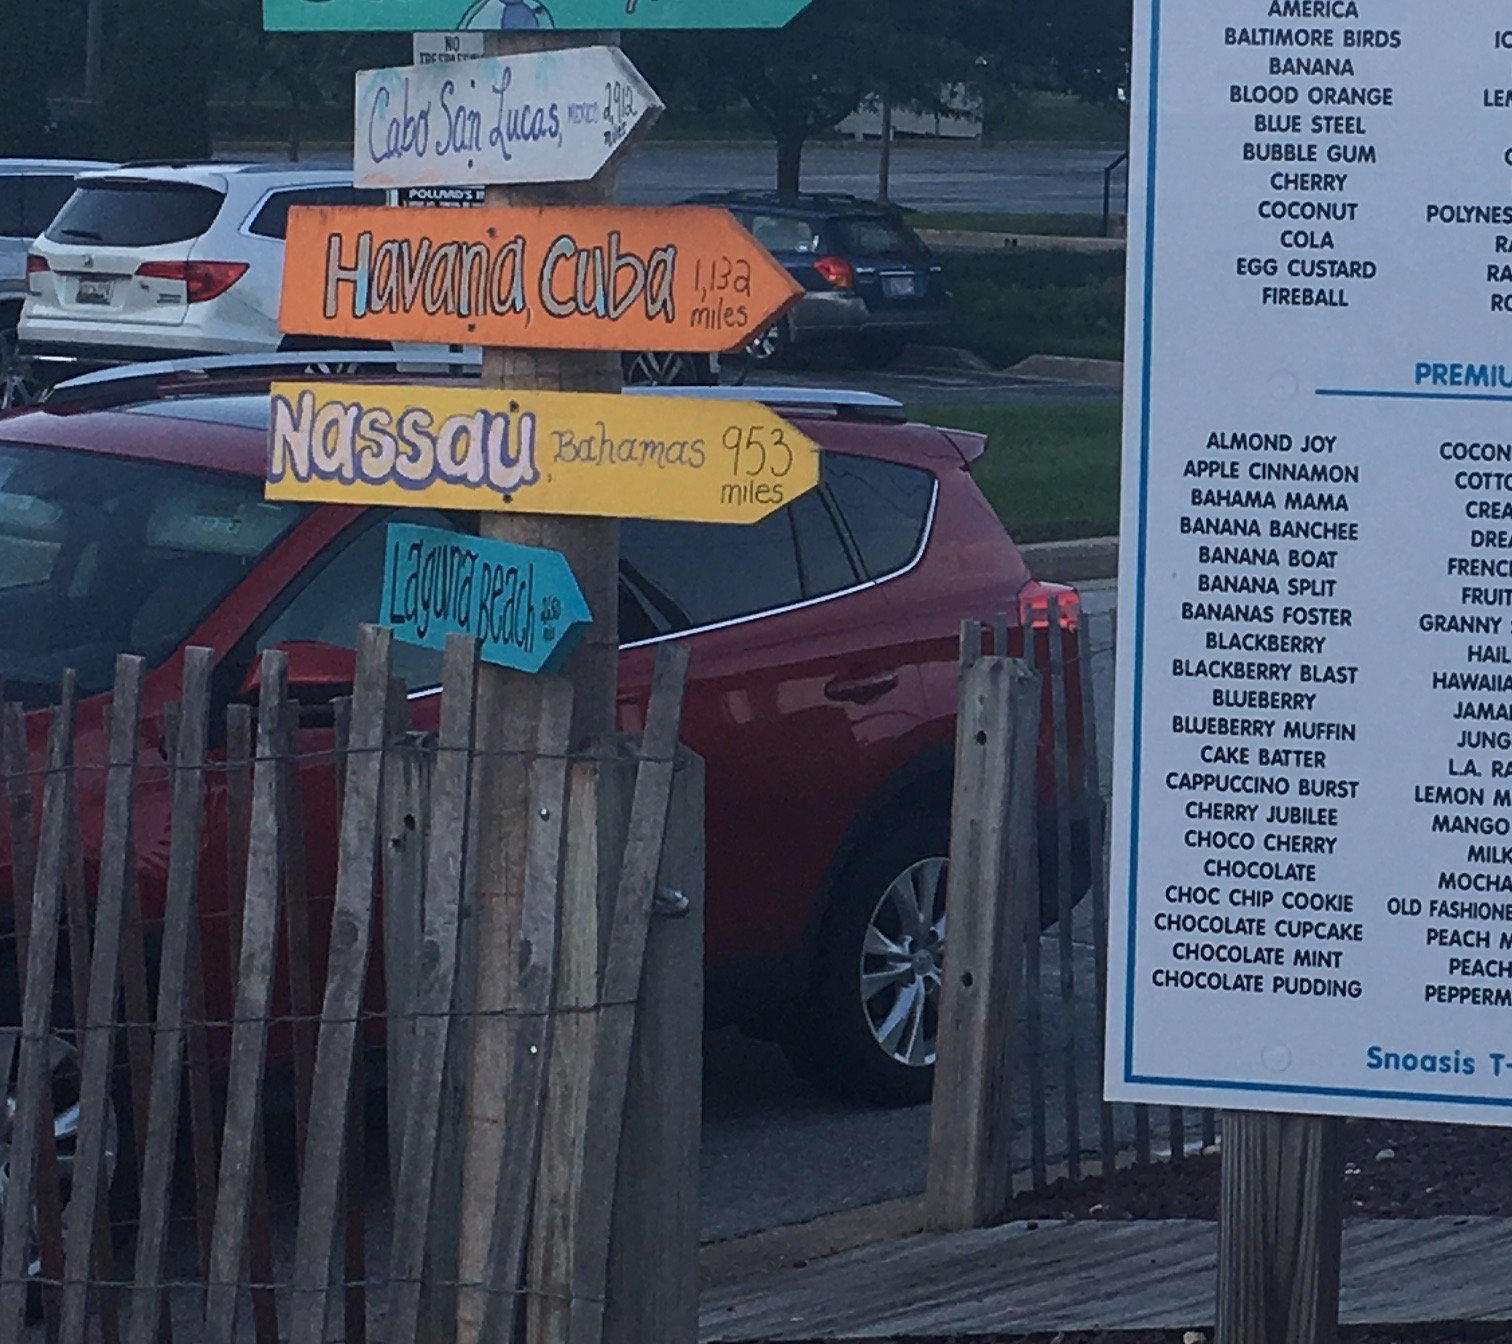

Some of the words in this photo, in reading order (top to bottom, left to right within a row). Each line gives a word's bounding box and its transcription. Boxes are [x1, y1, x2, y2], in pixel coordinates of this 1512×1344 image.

[1267, 0, 1359, 19] AMERICA
[444, 36, 460, 52] NO
[1224, 26, 1334, 48] BALTIMORE
[1343, 28, 1402, 49] BIRDS
[1229, 84, 1299, 105] BLOOD
[1307, 86, 1393, 106] ORANGE
[368, 77, 431, 164] Cabo
[436, 80, 482, 156] San
[1242, 141, 1318, 162] BUBBLE
[1326, 143, 1377, 164] GUM
[1257, 200, 1359, 221] COCONUT
[538, 232, 678, 322] Cuba
[1236, 257, 1279, 277] EGG
[1287, 258, 1377, 280] CUSTARD
[1262, 286, 1349, 307] FIREBALL
[690, 299, 748, 329] miles
[551, 421, 706, 469] Bahamas
[720, 424, 793, 478] 953
[1205, 431, 1293, 452] ALMOND
[1299, 434, 1338, 454] JOY
[719, 480, 784, 506] miles
[1190, 487, 1277, 510] BAHAMA
[1284, 491, 1349, 512] MAMA
[1180, 515, 1262, 538] BANANA
[1269, 519, 1359, 542] BANCHEE
[389, 538, 479, 639] Laguna
[477, 561, 536, 653] Beach
[1418, 613, 1503, 635] GRANNY
[1205, 631, 1327, 655] BLACKBERRY
[1448, 757, 1483, 778] L.A.
[1165, 771, 1291, 796] CAPPUCCINO
[1298, 778, 1360, 799] BURST
[1151, 968, 1264, 993] CHOCOLATE
[1272, 975, 1363, 999] PUDDING
[1366, 1045, 1476, 1076] Snoasis
